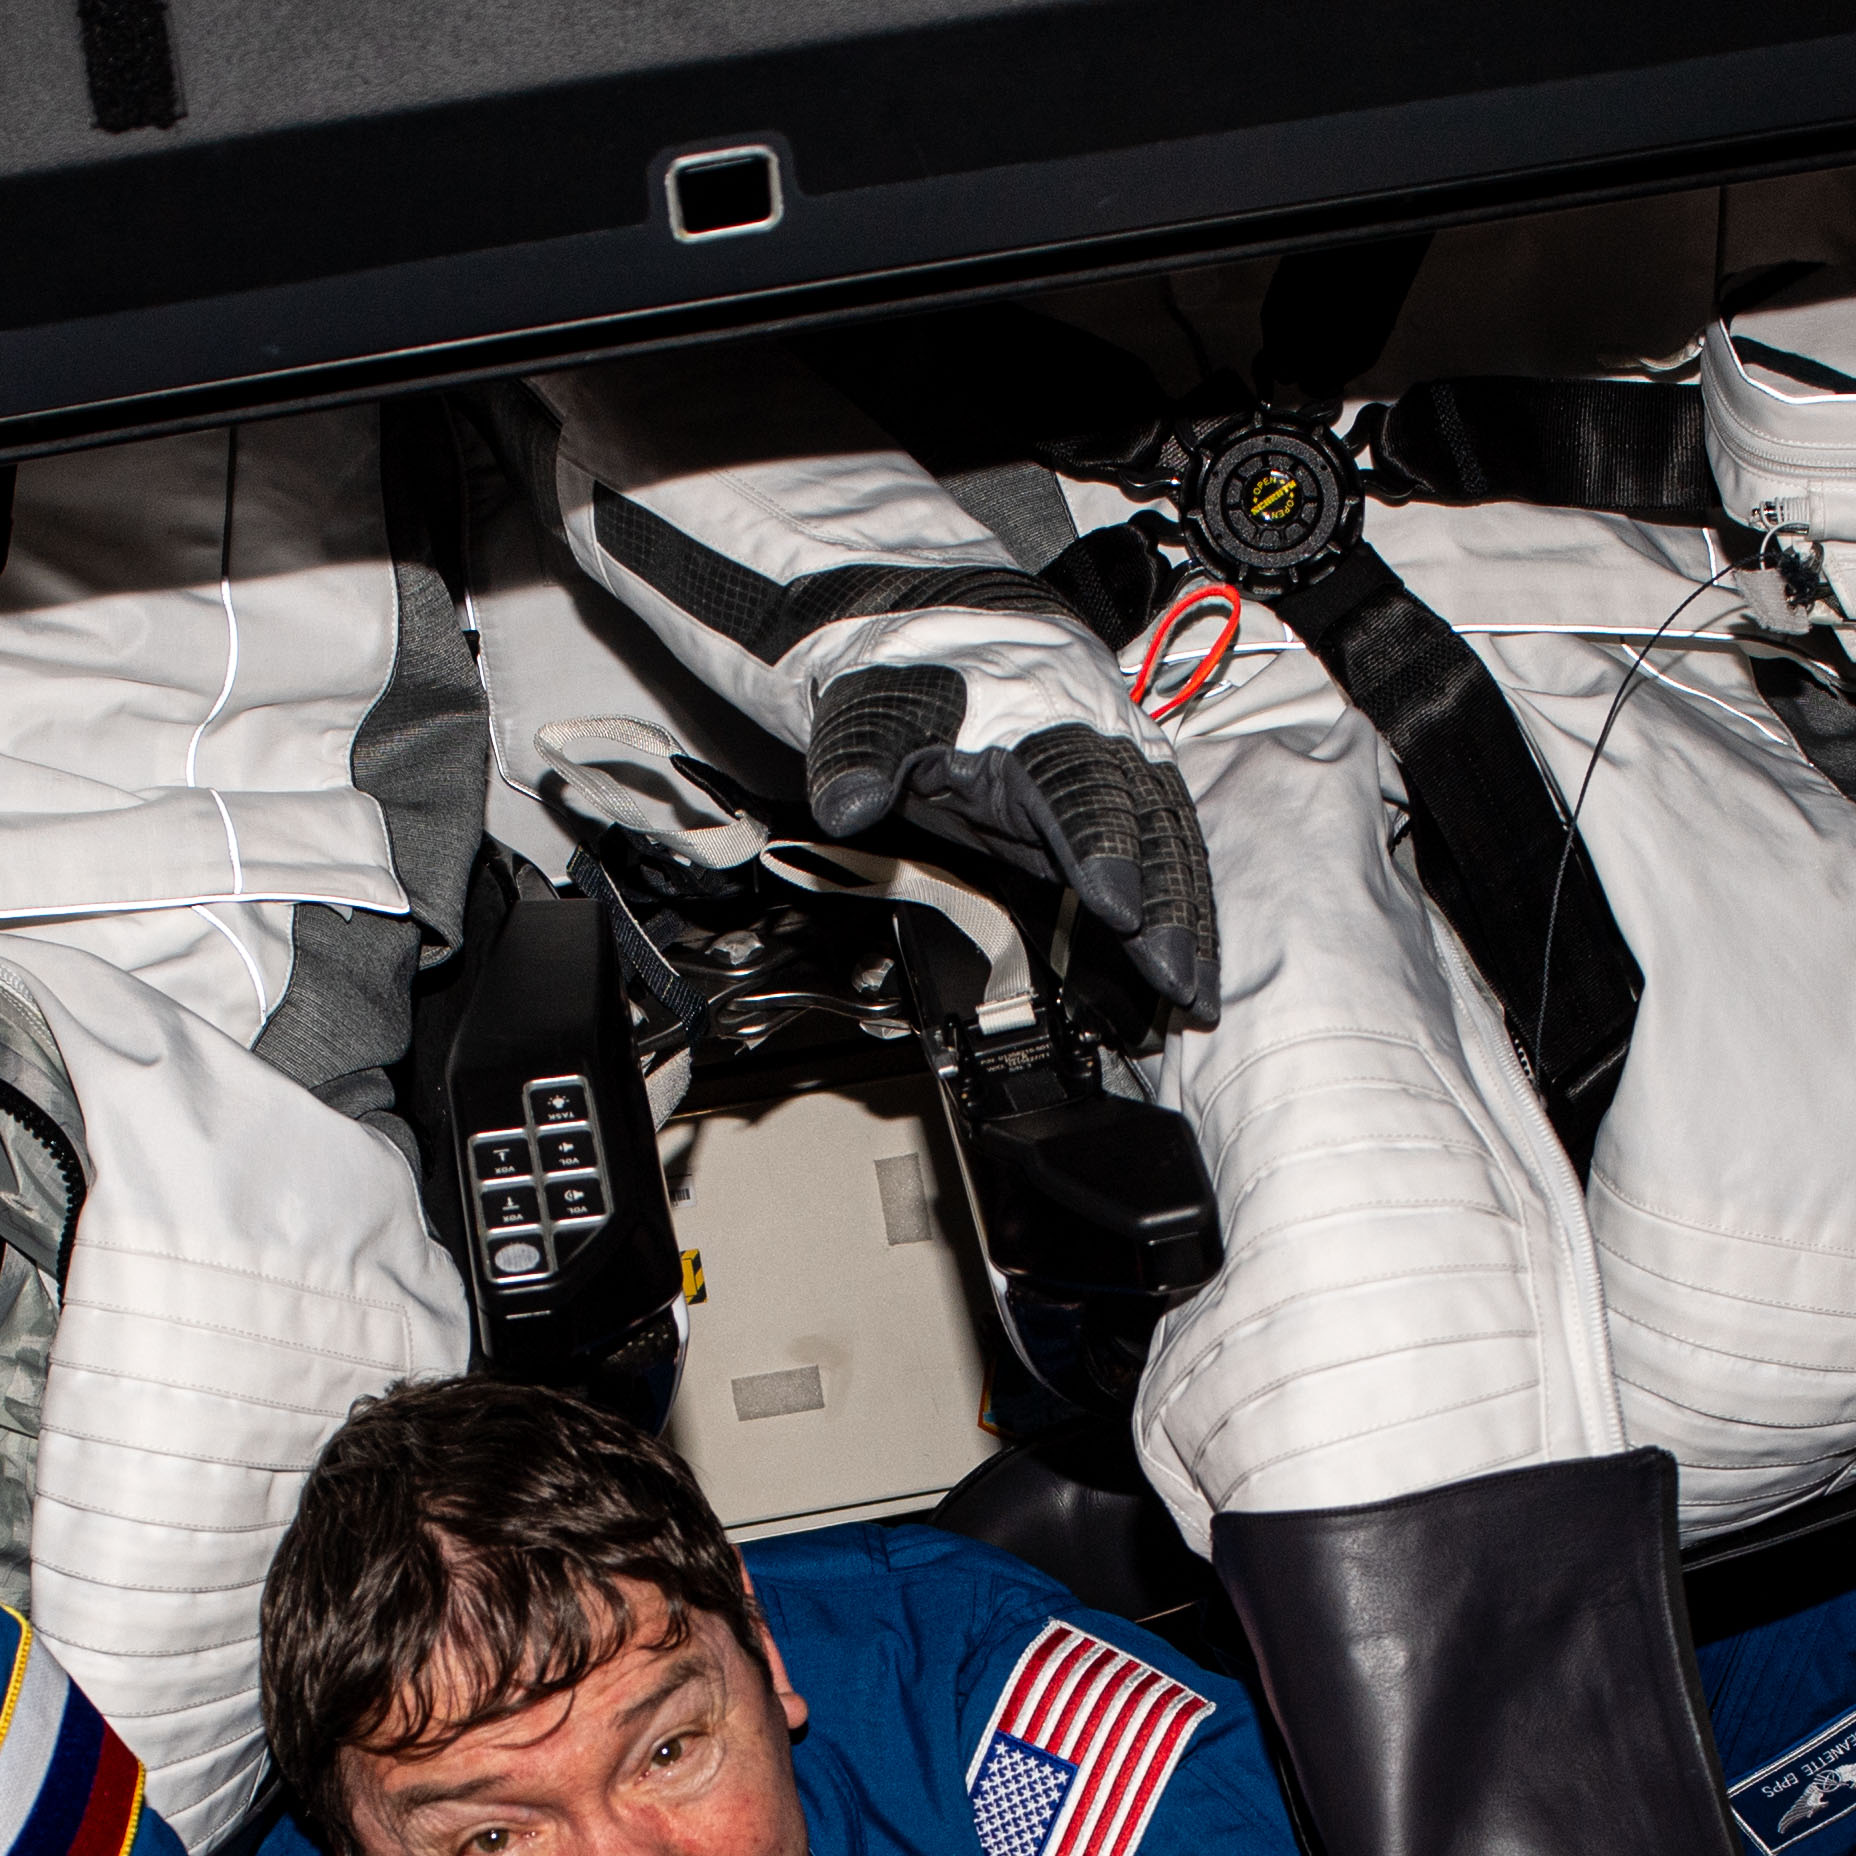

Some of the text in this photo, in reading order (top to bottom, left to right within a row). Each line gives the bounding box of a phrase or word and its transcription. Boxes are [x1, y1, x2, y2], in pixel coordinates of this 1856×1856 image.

[547, 1111, 575, 1120] TASK
[559, 1157, 580, 1166] VOL
[494, 1166, 516, 1174] VOX
[567, 1206, 588, 1214] VOL
[502, 1214, 523, 1222] VOX
[1761, 1772, 1800, 1798] EPPS
